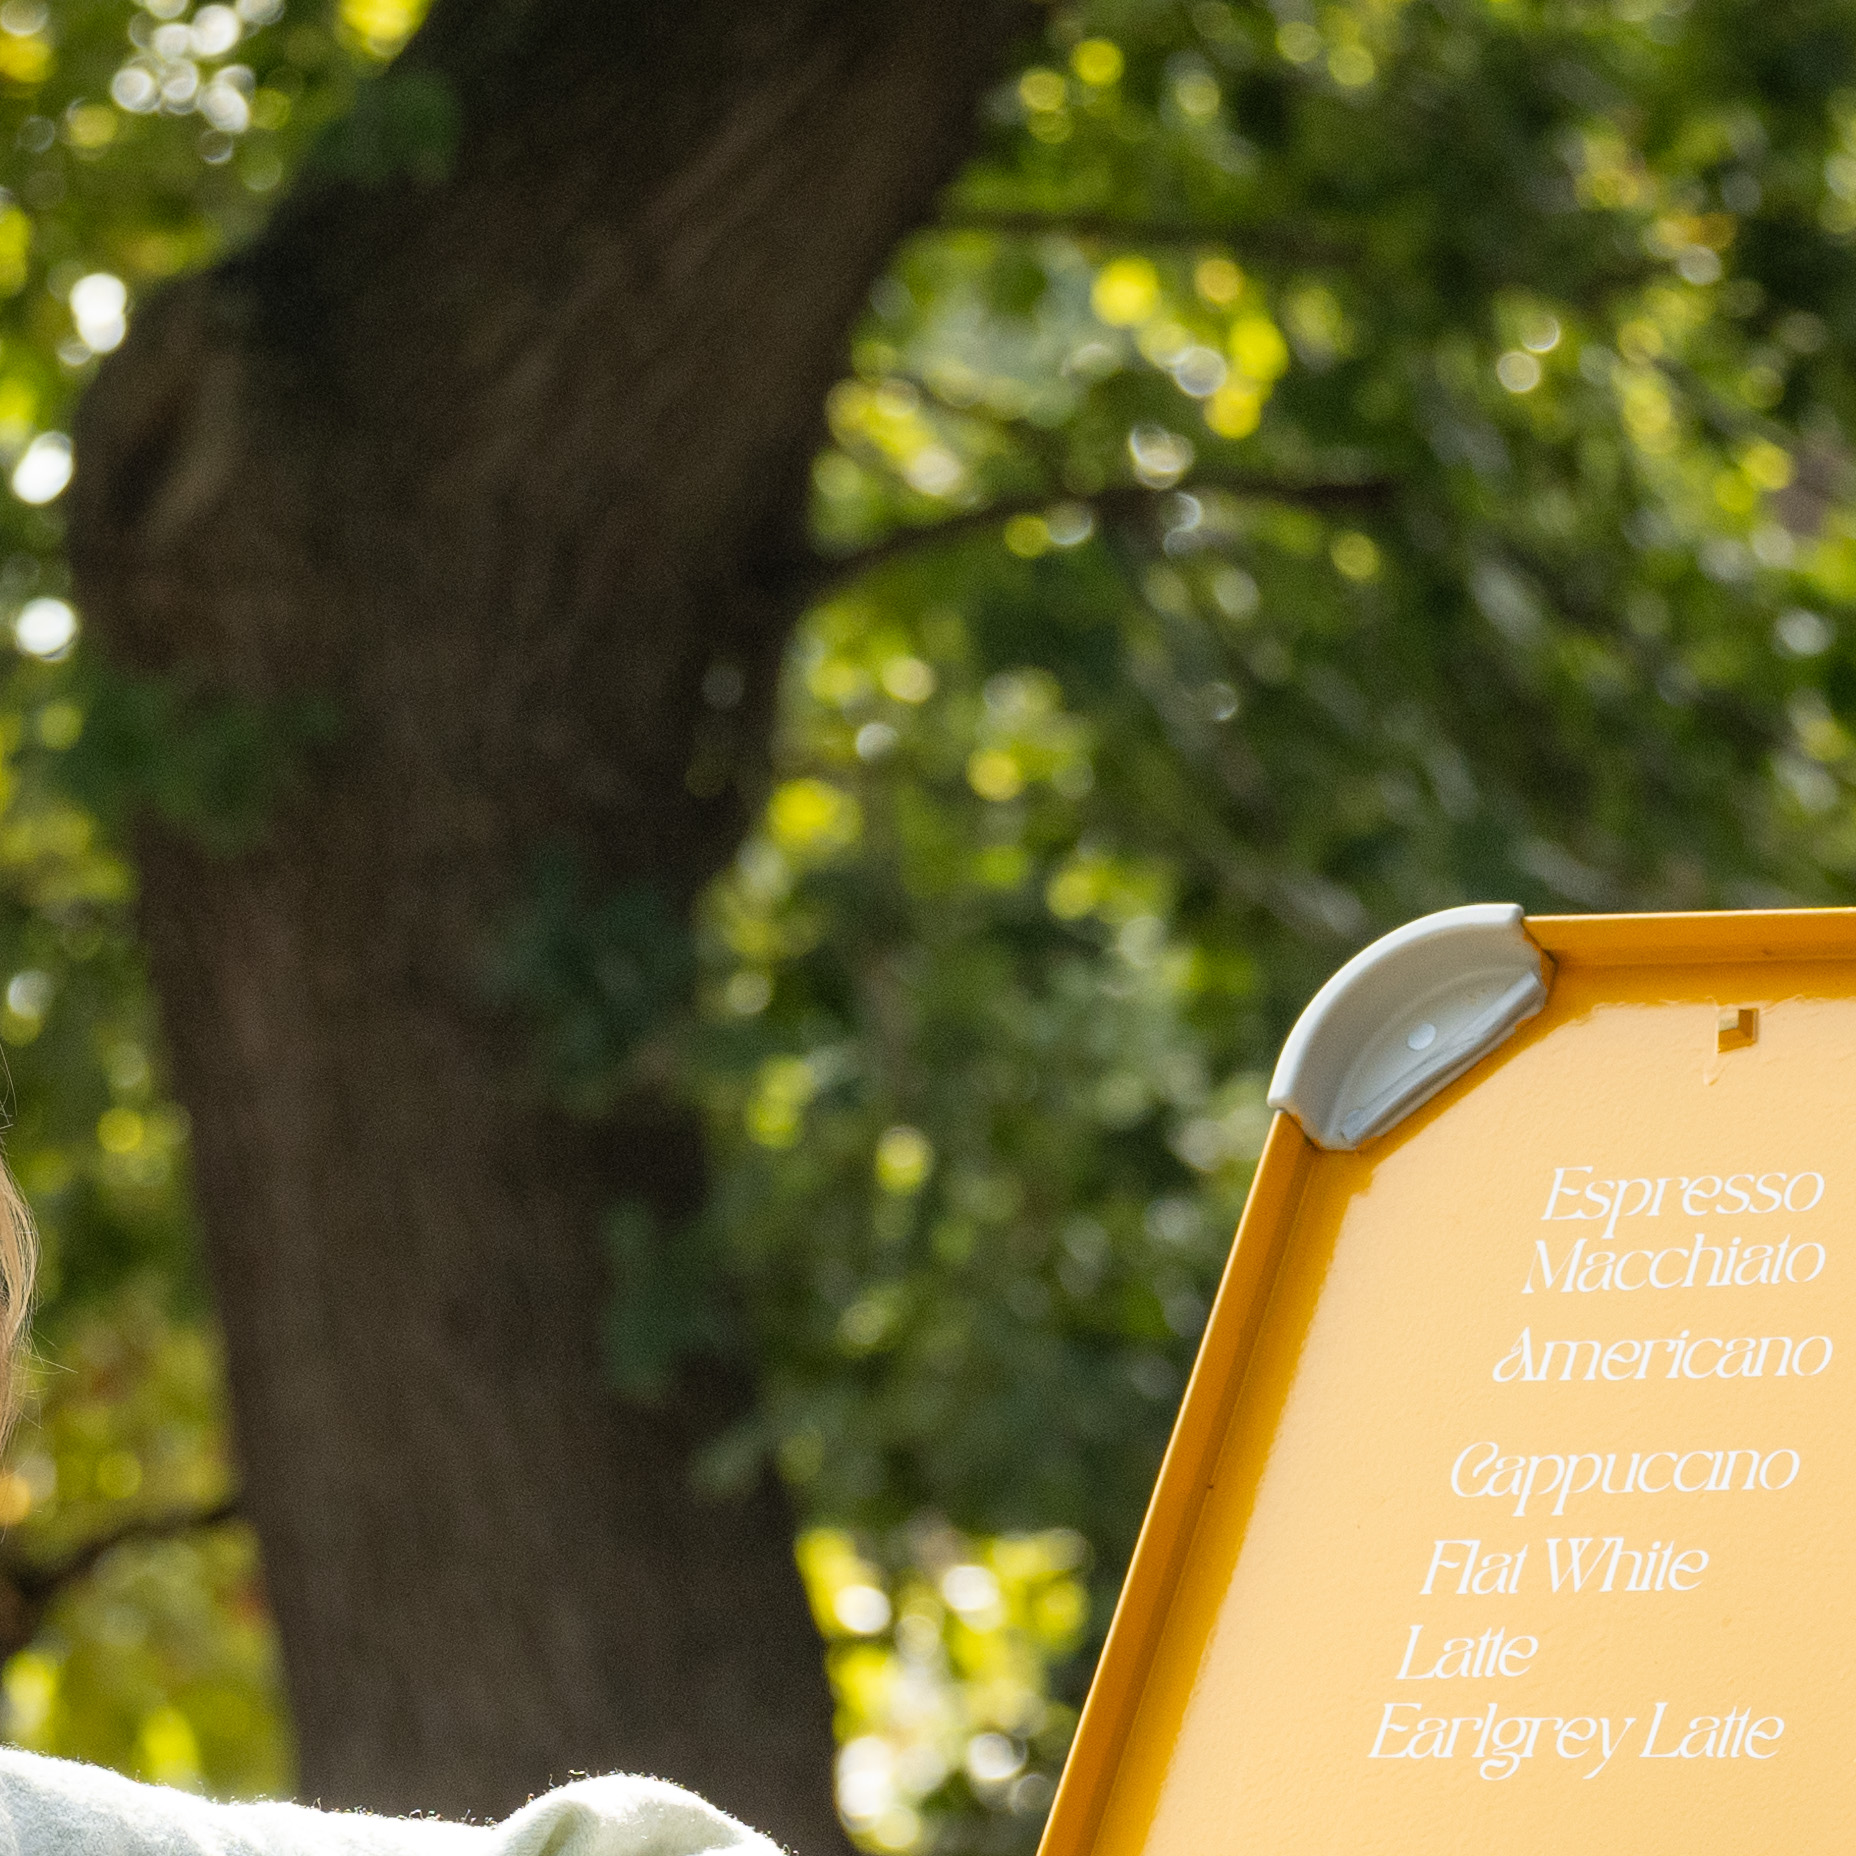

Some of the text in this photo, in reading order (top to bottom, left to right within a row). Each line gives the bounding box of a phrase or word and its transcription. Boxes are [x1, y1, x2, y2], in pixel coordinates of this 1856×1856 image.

[1541, 1165, 1825, 1239] Espresso
[1522, 1233, 1826, 1294] Macchiato
[1492, 1326, 1833, 1382] Americano
[1451, 1441, 1800, 1517] Cappuccino
[1420, 1537, 1709, 1595] Flat White
[1396, 1625, 1539, 1680] Latte
[1368, 1702, 1784, 1780] Earlgrey Latte
